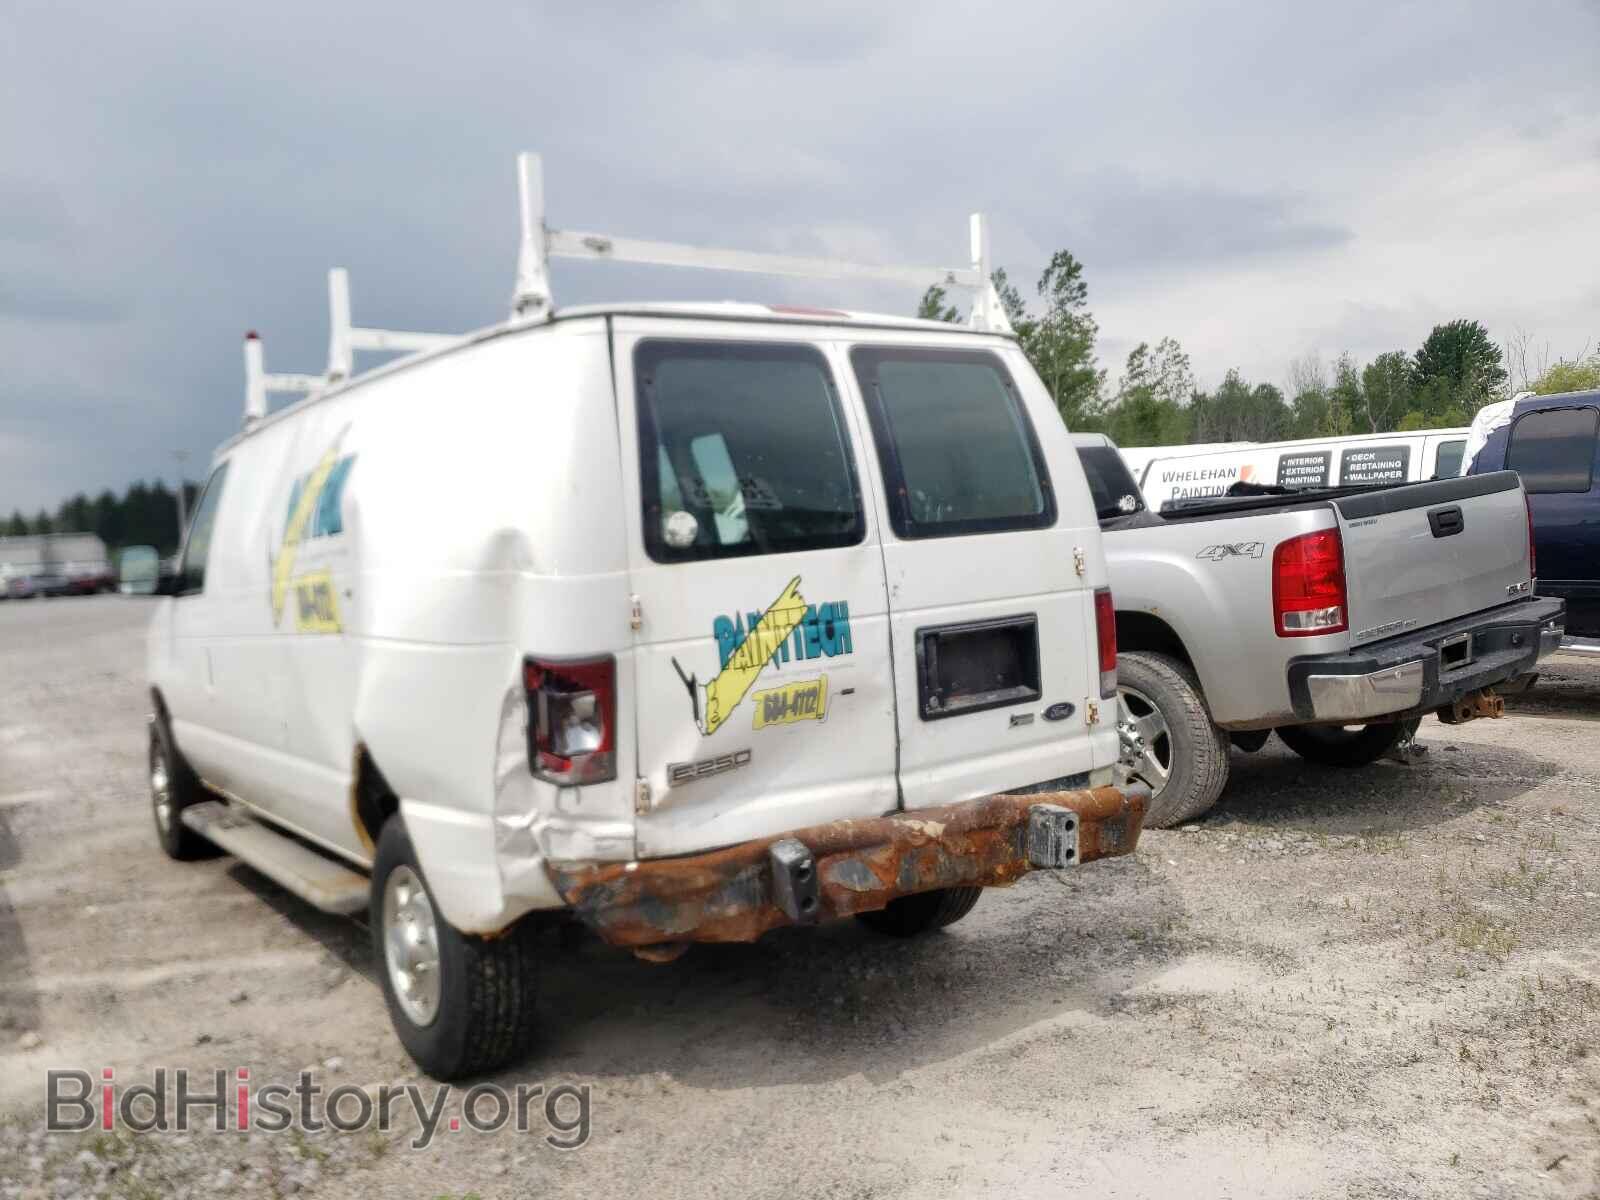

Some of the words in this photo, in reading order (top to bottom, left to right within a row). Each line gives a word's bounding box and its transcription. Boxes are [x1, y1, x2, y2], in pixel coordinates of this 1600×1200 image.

[1287, 456, 1325, 467] INTERIOR
[1351, 452, 1376, 461] DECK
[1286, 465, 1325, 476] EXTERIOR
[1350, 460, 1402, 471] RESTAINING
[1162, 467, 1237, 483] WHELEHAN
[1349, 470, 1402, 482] WALLPAPER
